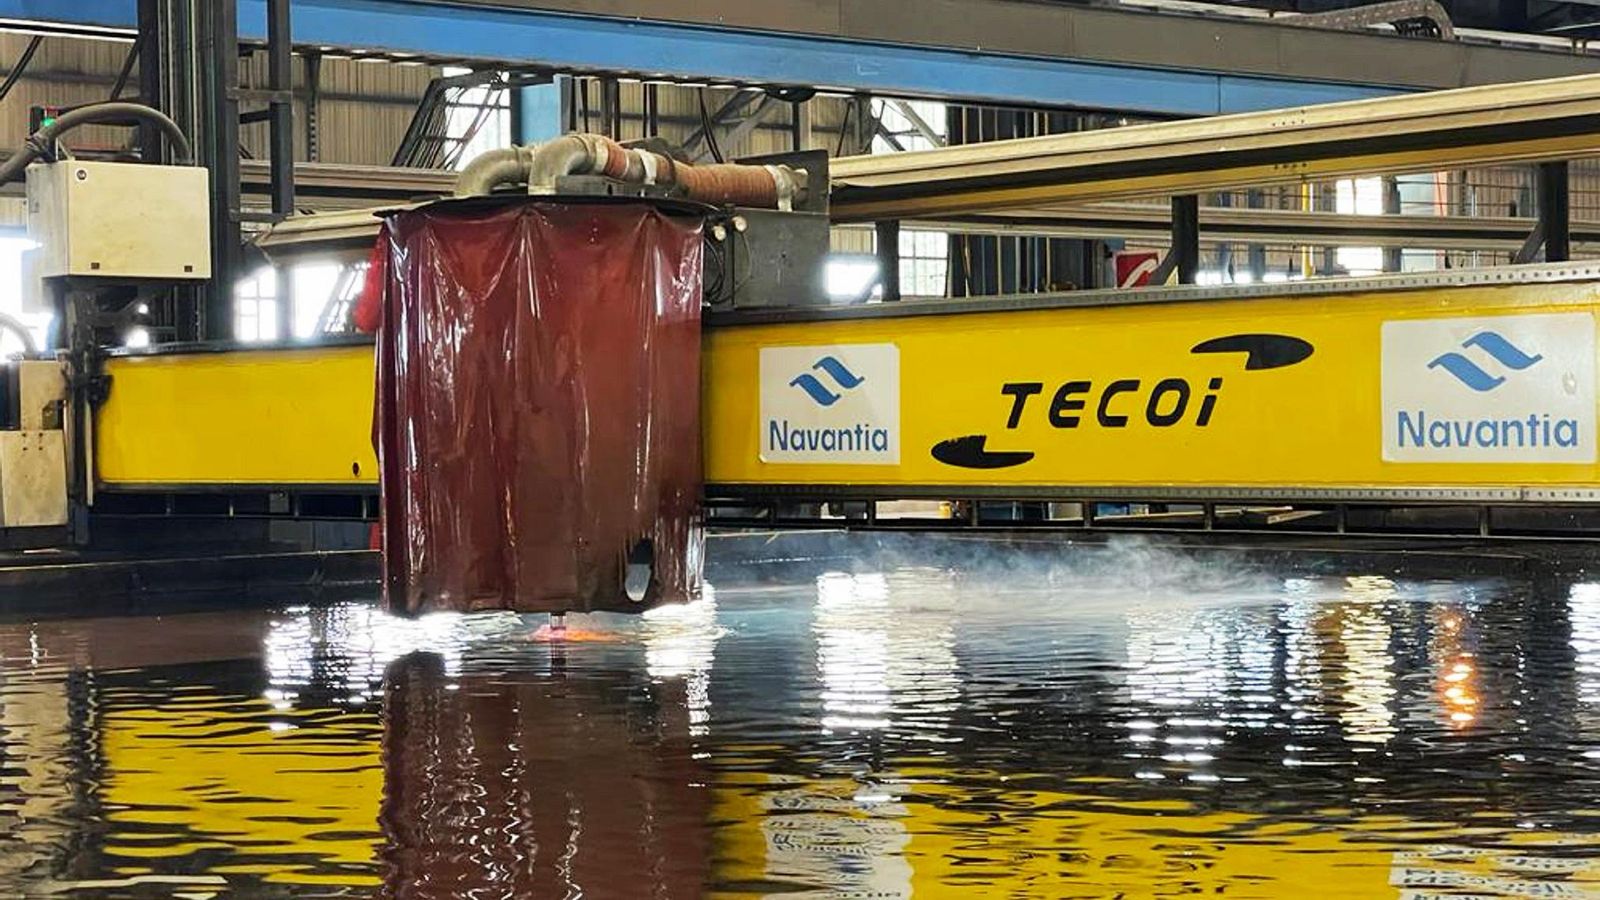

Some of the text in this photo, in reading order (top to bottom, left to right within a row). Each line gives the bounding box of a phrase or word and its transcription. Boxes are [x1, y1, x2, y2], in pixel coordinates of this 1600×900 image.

[1001, 378, 1223, 429] TECOi
[769, 420, 888, 451] Navantia
[1397, 410, 1578, 447] Navantia
